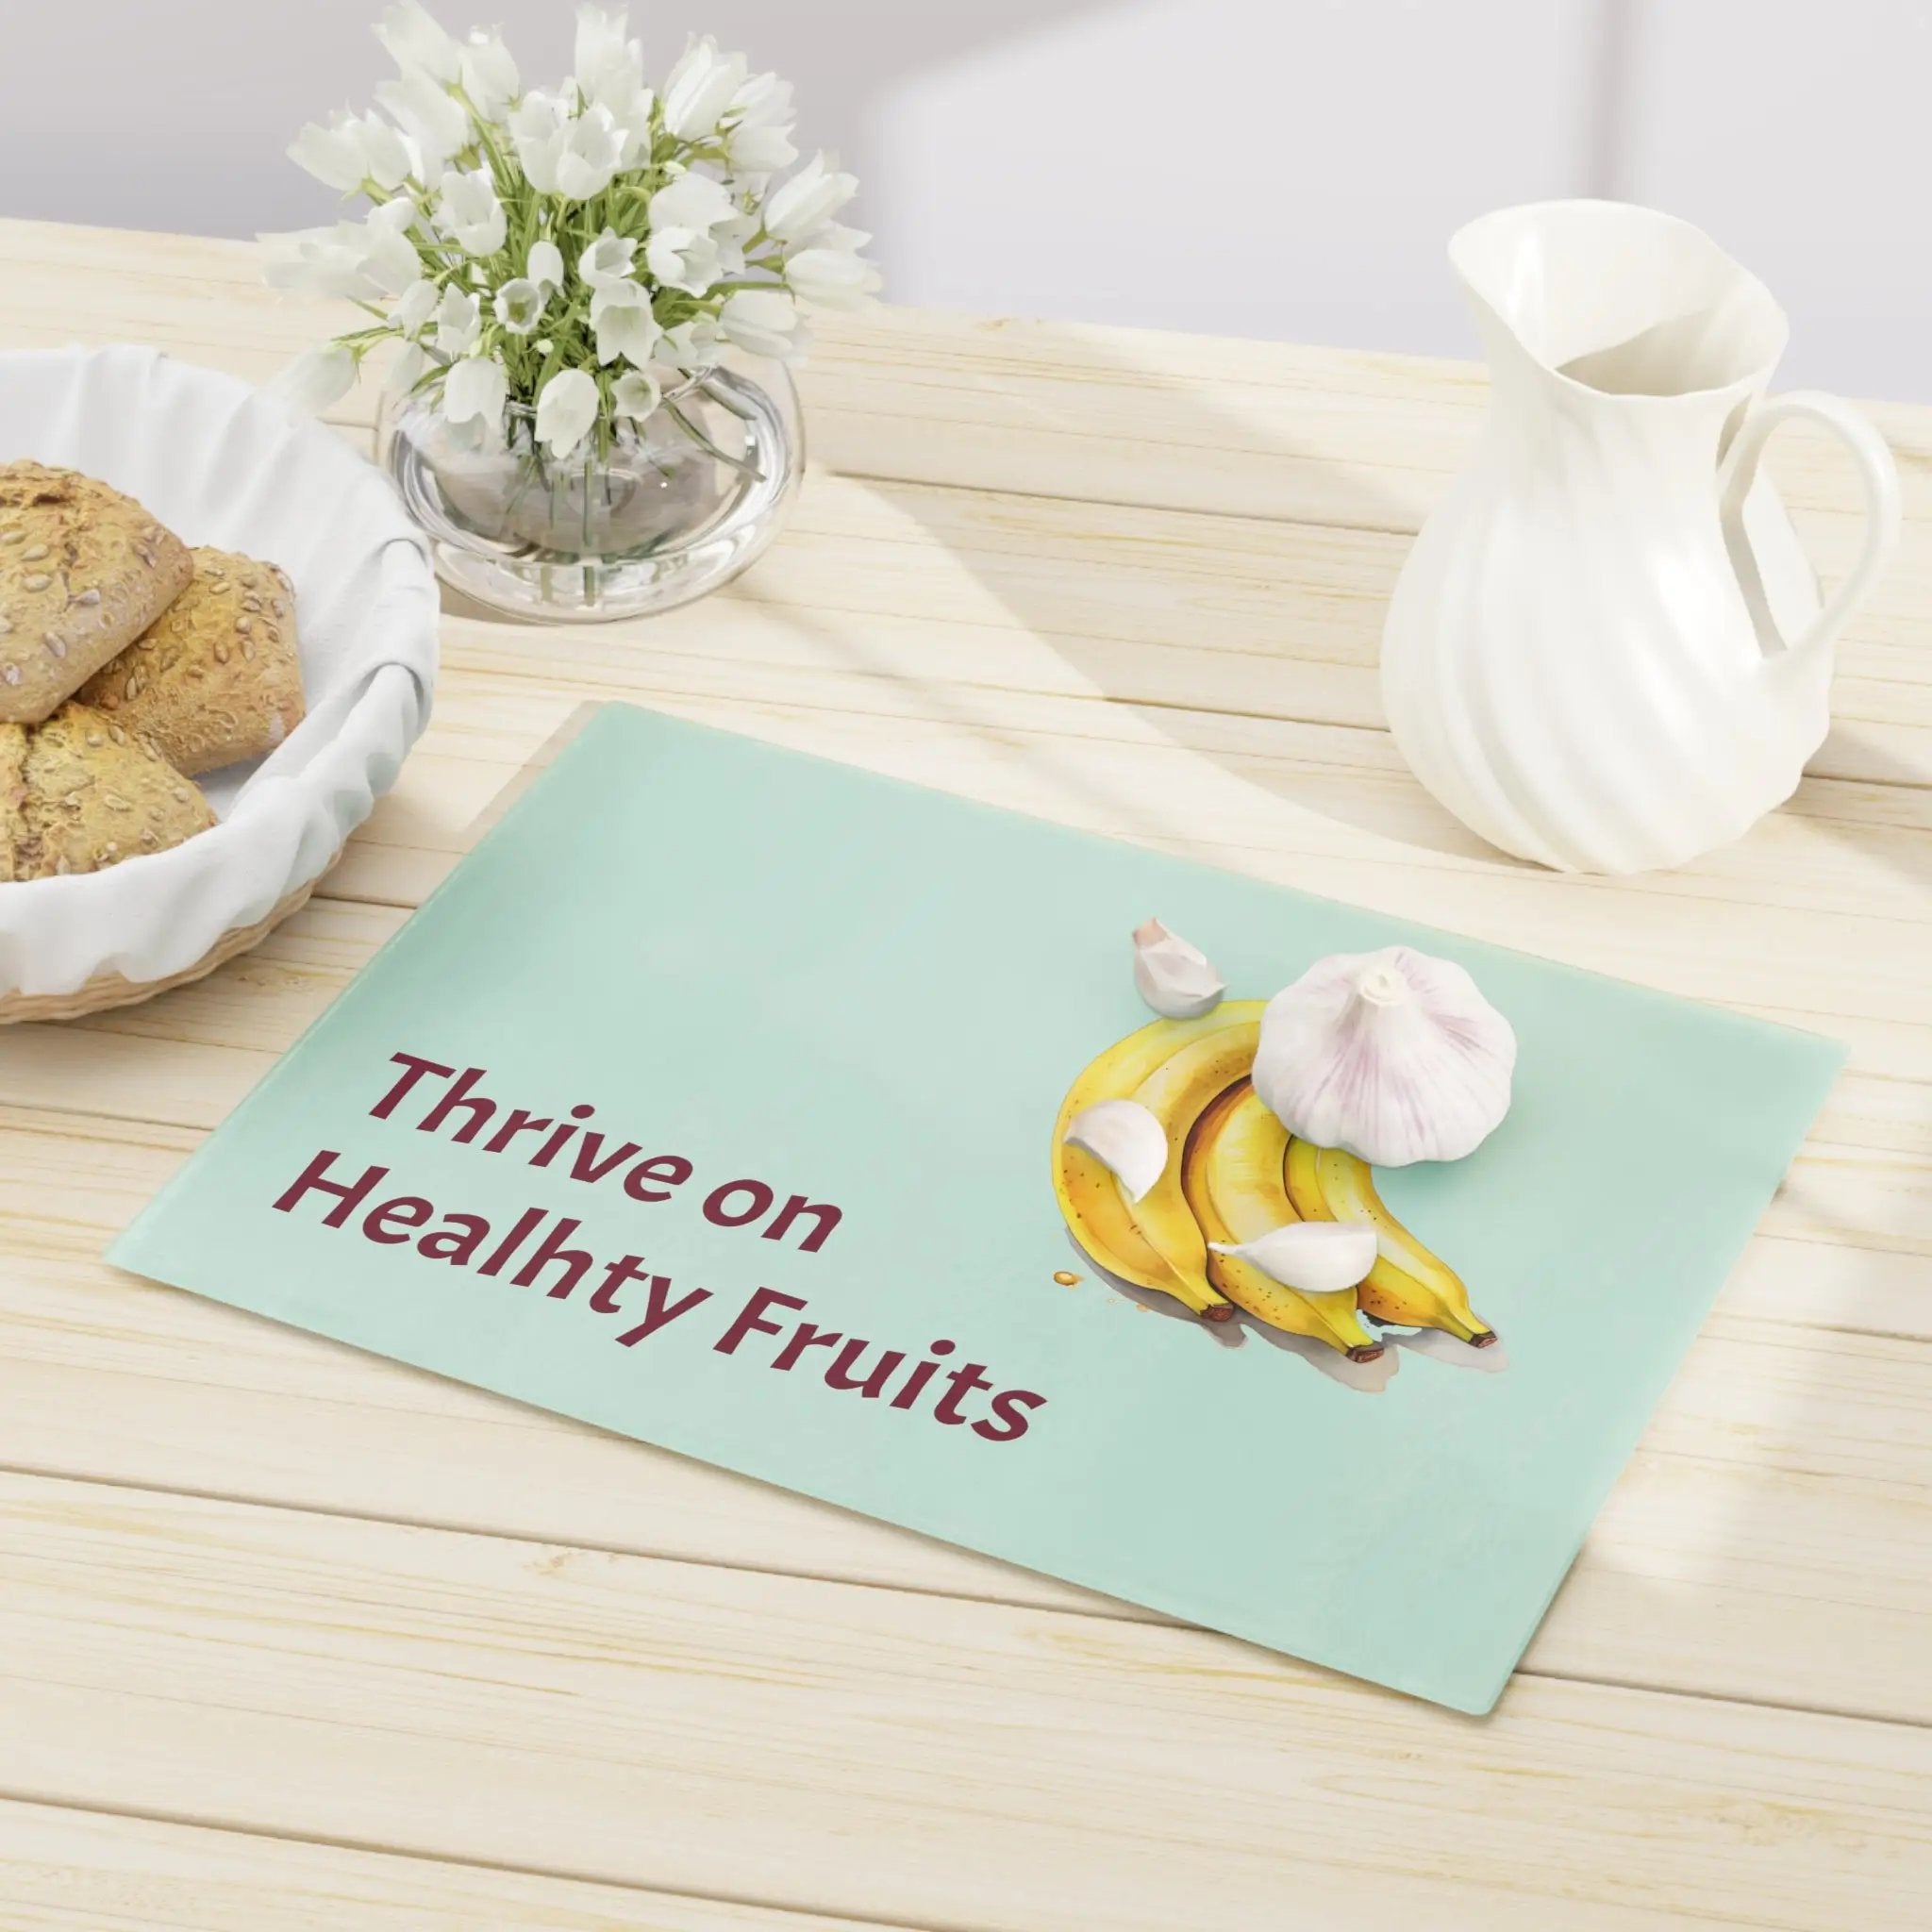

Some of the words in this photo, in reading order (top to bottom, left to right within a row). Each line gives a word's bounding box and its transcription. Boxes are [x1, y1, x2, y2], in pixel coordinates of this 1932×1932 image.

[370, 1052, 693, 1202] Thrive
[703, 1179, 842, 1252] on
[274, 1150, 712, 1347] Healhty
[714, 1287, 1046, 1441] Fruits
